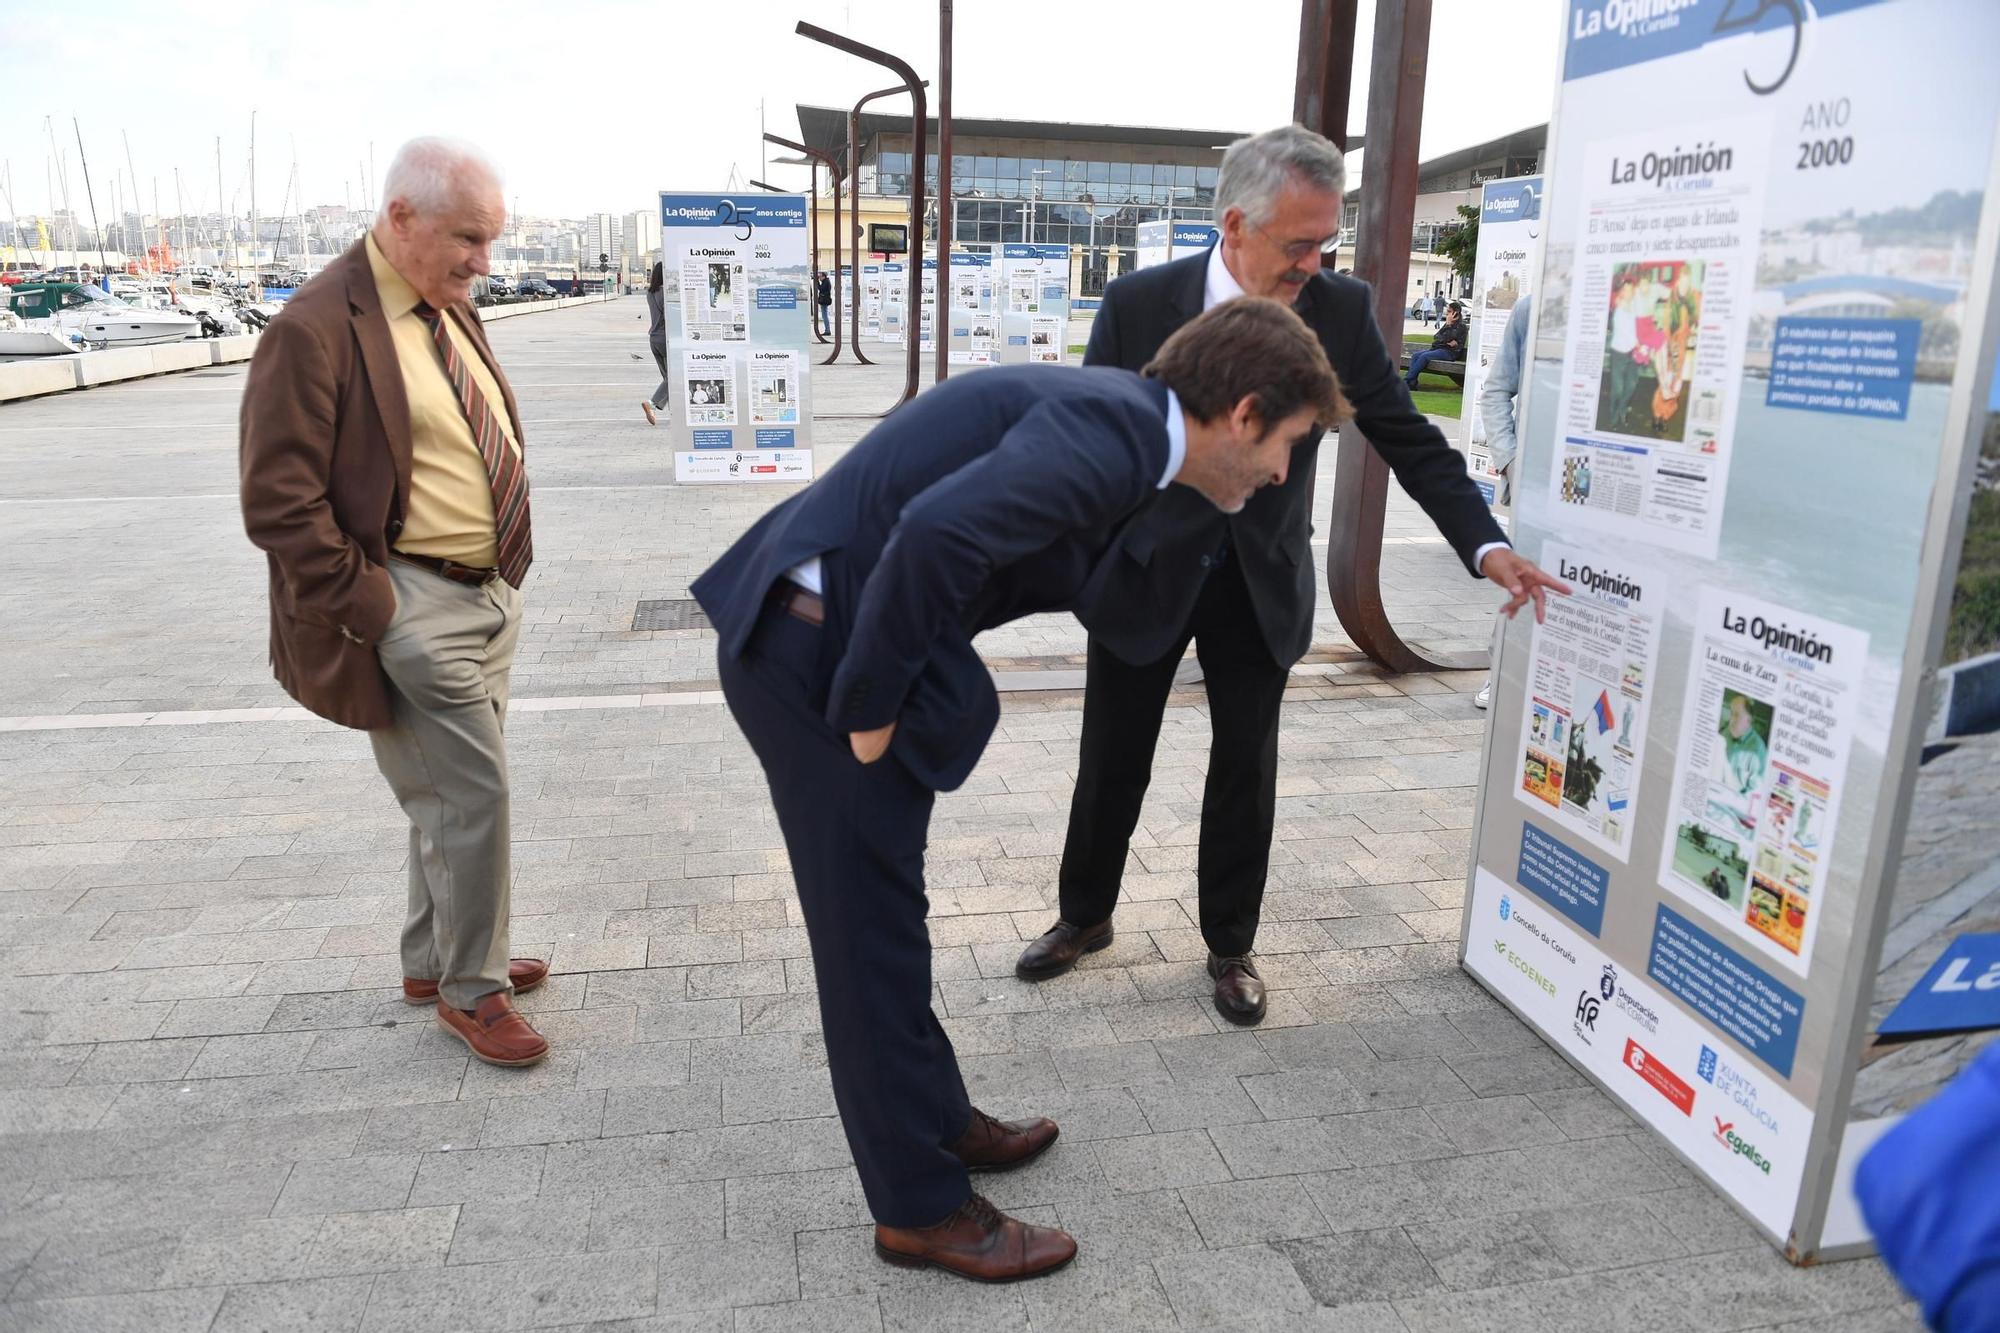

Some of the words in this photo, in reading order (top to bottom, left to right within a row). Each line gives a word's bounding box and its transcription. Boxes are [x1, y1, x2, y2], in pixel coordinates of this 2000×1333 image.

[1575, 8, 1601, 39] La
[1801, 97, 1851, 132] ANO
[1611, 157, 1636, 184] La
[1642, 141, 1732, 187] Opinión
[1797, 135, 1853, 169] 2000
[666, 208, 678, 217] La
[679, 207, 716, 219] Opinión
[718, 199, 757, 241] 25
[775, 209, 803, 219] contigo
[1486, 200, 1494, 210] La
[1494, 197, 1520, 212] Opinión
[690, 248, 700, 256] La
[702, 248, 735, 259] Opinión
[755, 251, 771, 259] 2002
[1183, 232, 1208, 241] Opinión
[1495, 251, 1502, 260] La
[1503, 250, 1527, 262] Opinión
[1560, 558, 1577, 581] La
[1581, 565, 1642, 601] Opinión
[1723, 607, 1746, 634] La
[1751, 617, 1832, 664] Opinión
[1706, 647, 1718, 661] La
[1720, 655, 1741, 671] cuna
[1743, 661, 1754, 675] de
[1756, 662, 1778, 684] Zara
[1531, 832, 1553, 851] Tribunal
[1552, 845, 1577, 867] Supremo
[1513, 911, 1540, 937] Concello
[1541, 932, 1550, 945] da
[1551, 940, 1576, 964] Coruña
[1508, 951, 1557, 998] ECOENER
[1723, 958, 1755, 986] Amancio
[1755, 979, 1782, 1004] Ortega
[1618, 987, 1659, 1025] Deputación
[1721, 1062, 1757, 1099] XUNTA
[1717, 1076, 1730, 1095] DE
[1734, 1090, 1778, 1135] GALICIA
[1715, 1115, 1771, 1175] Vegalsa
